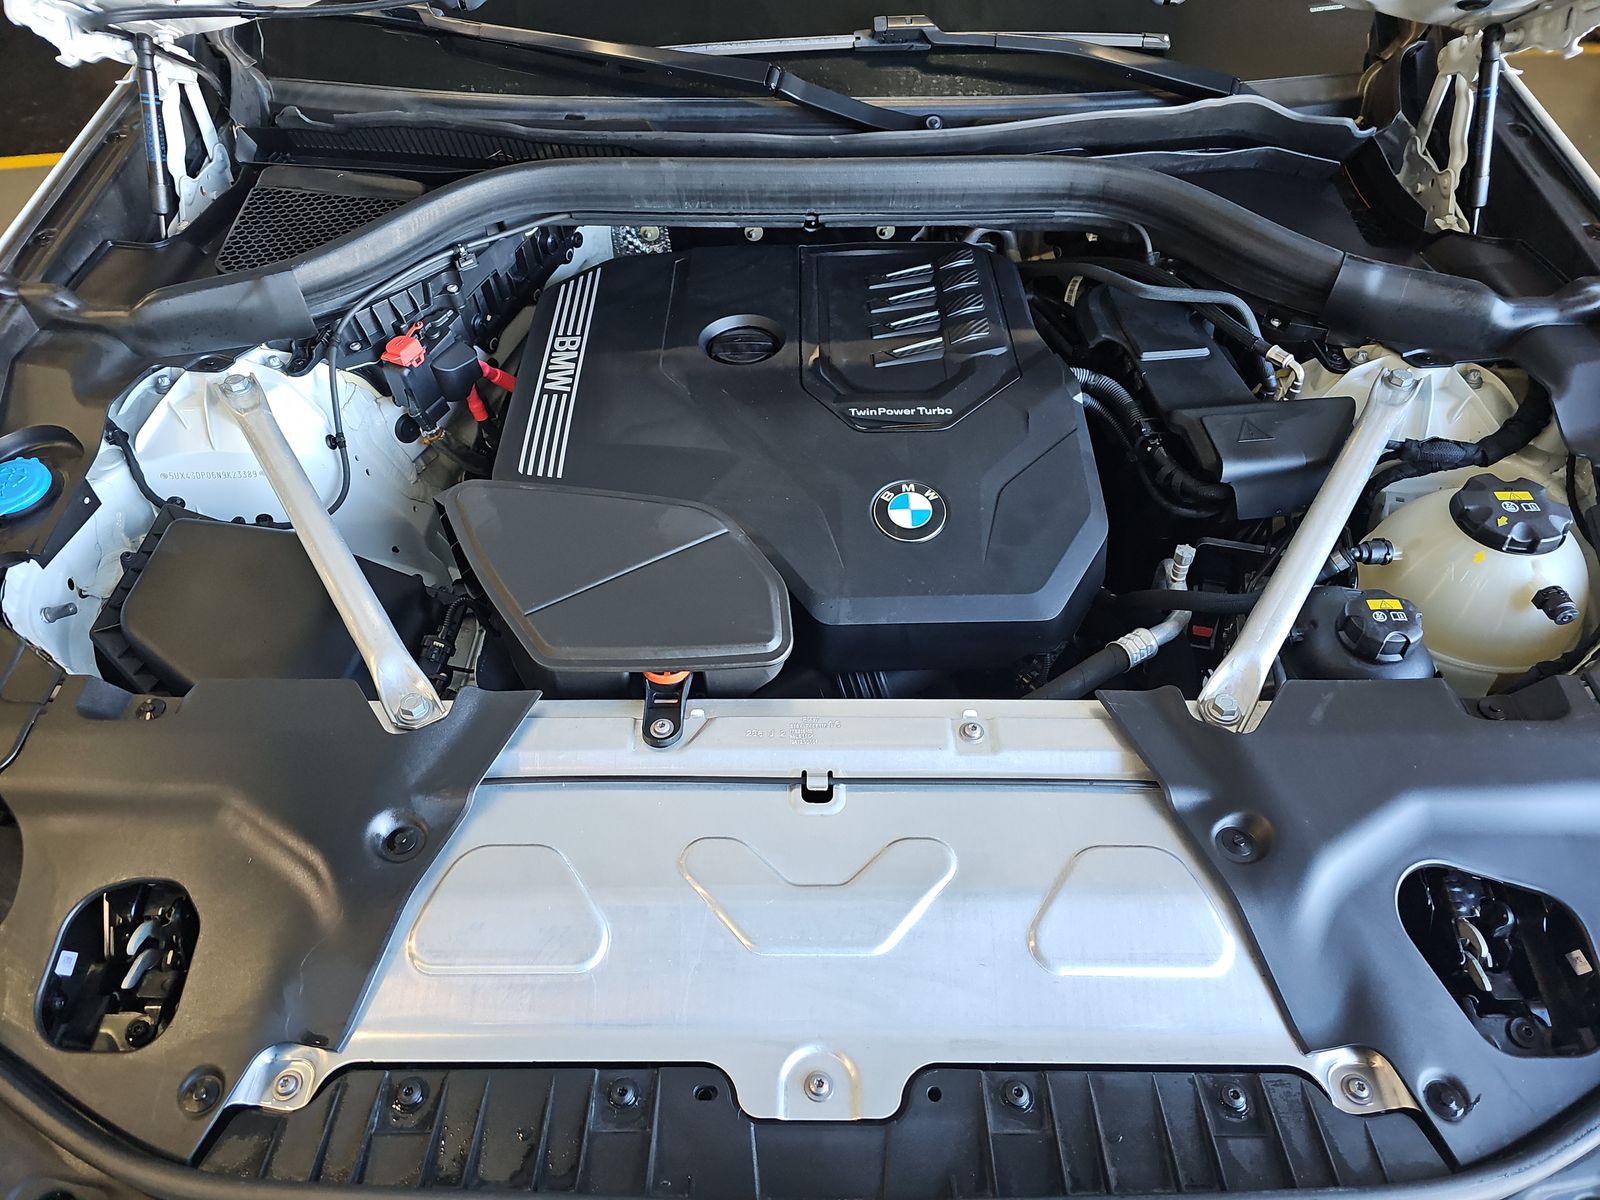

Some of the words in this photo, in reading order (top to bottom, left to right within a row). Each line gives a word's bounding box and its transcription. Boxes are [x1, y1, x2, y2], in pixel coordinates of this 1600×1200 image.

[544, 337, 581, 391] BMW
[917, 407, 952, 415] Turbo
[880, 483, 938, 502] BMW
